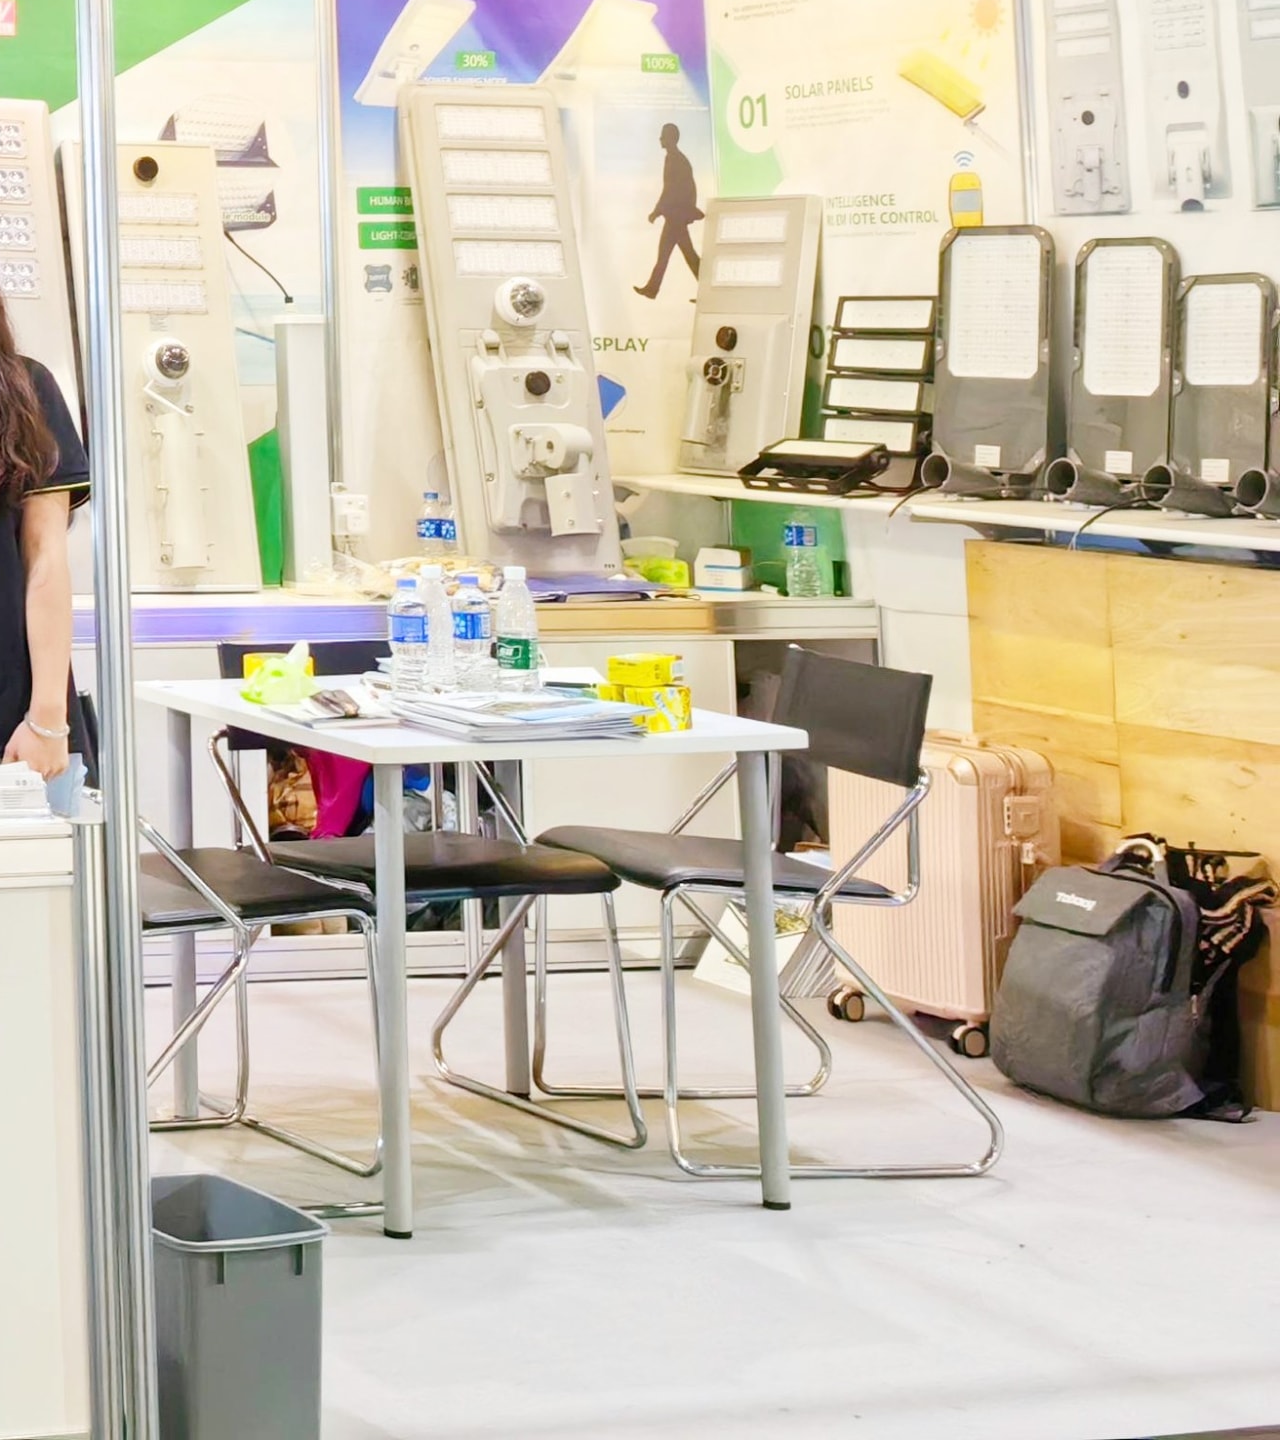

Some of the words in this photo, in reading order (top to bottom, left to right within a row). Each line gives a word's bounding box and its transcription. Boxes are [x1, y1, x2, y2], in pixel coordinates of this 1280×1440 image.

[462, 53, 489, 69] 30%
[785, 82, 825, 100] SOLAR
[827, 75, 874, 96] PANELS
[739, 92, 768, 130] 01
[880, 210, 939, 225] CONTROL
[592, 337, 648, 352] SPLAY
